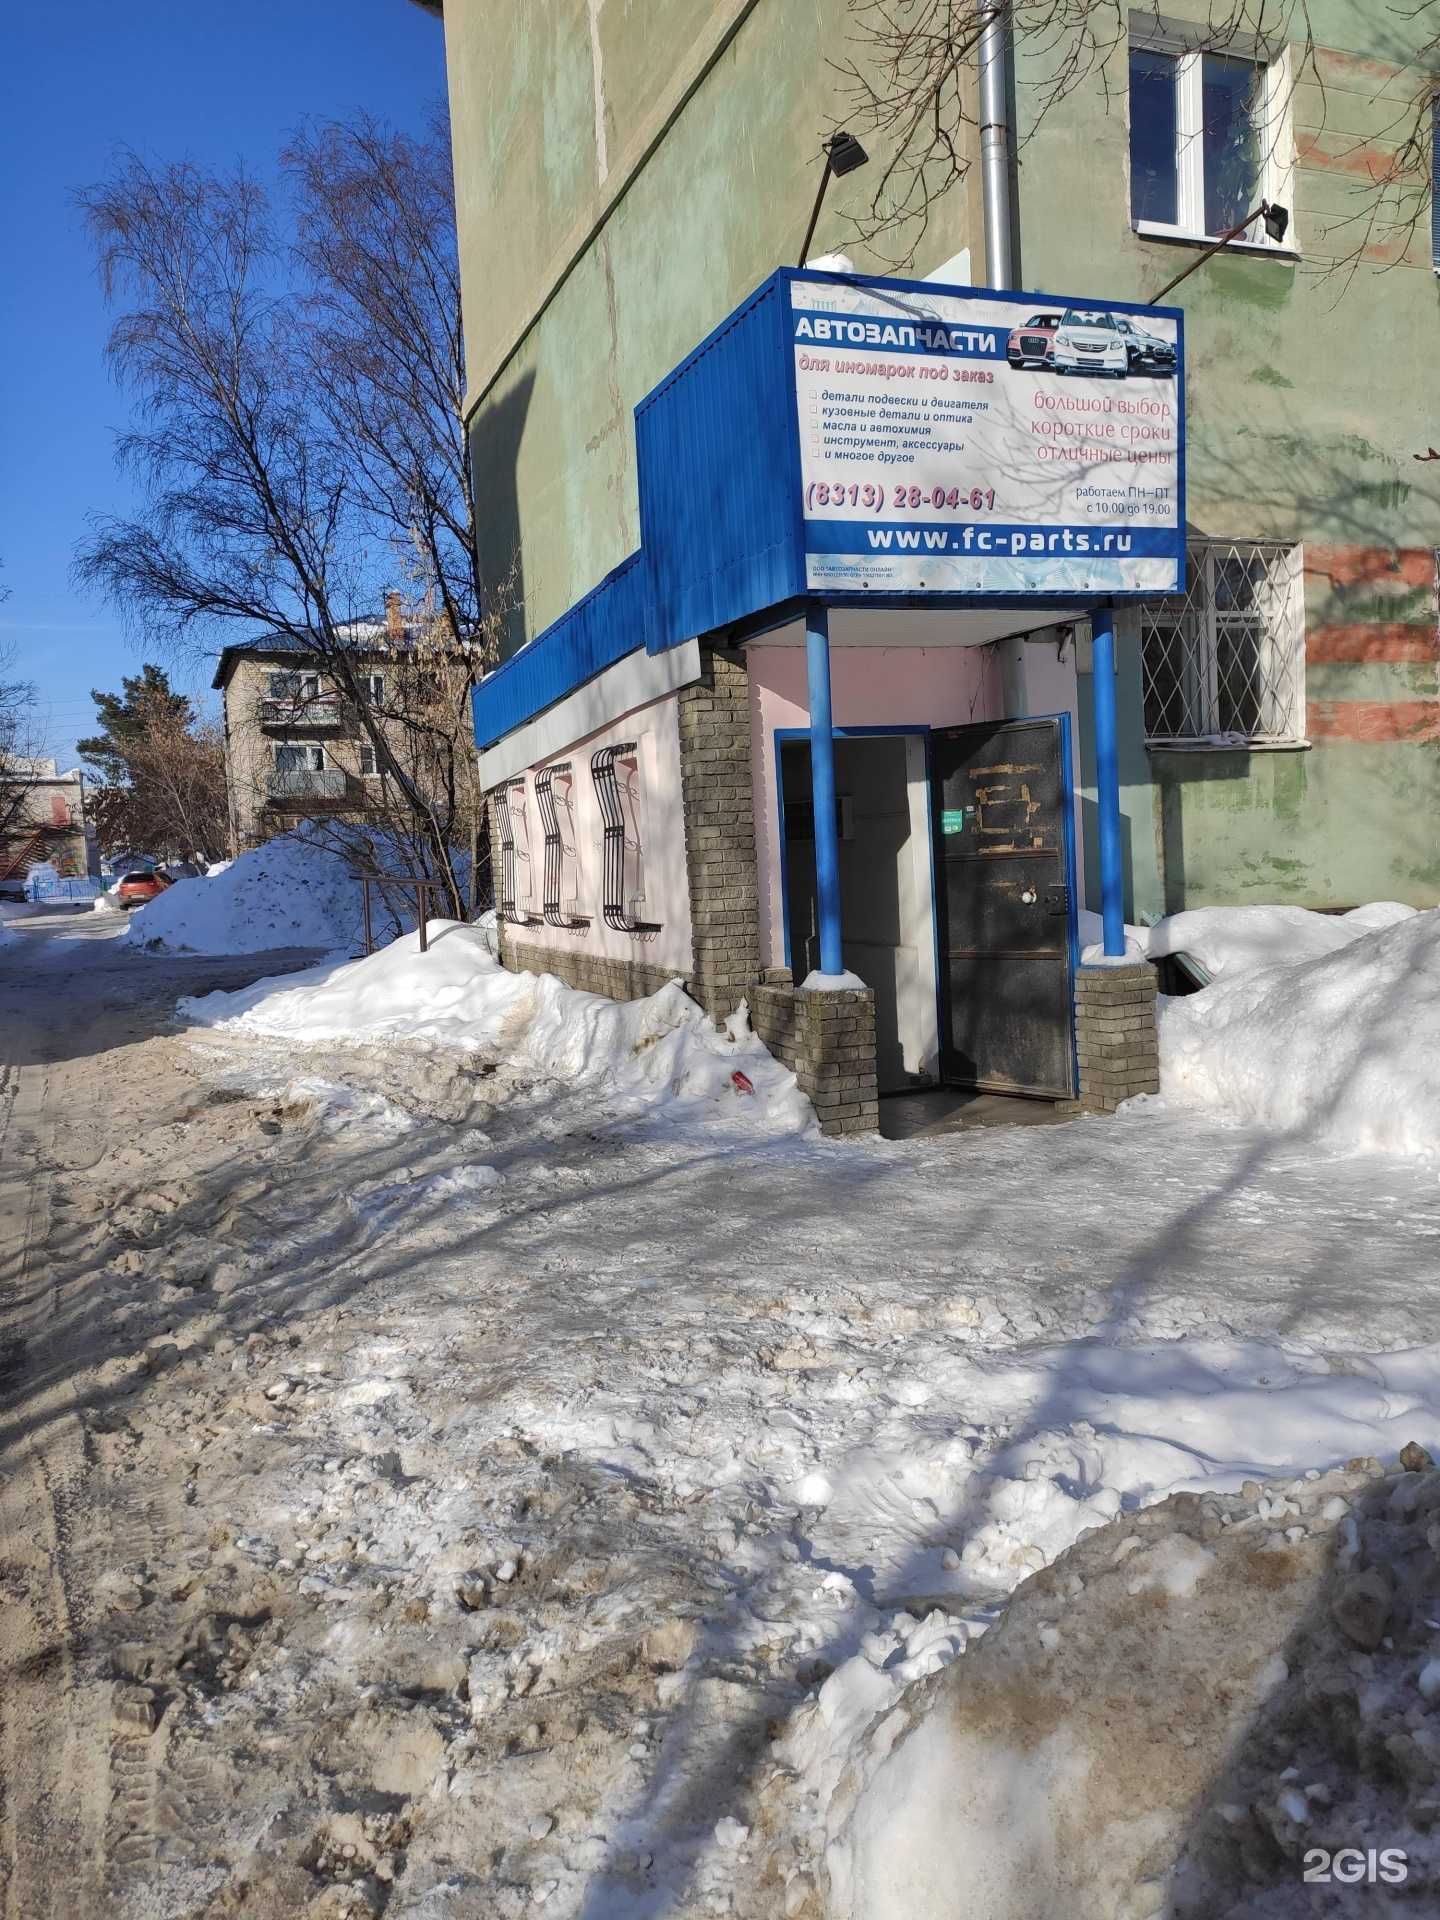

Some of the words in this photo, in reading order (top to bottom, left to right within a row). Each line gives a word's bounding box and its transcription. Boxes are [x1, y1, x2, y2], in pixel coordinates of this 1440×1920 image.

[795, 317, 996, 353] АВТОЗАПЧАСТИ
[799, 354, 830, 372] для
[834, 359, 914, 380] иномарок
[919, 365, 948, 380] под
[953, 369, 994, 384] заказ
[821, 390, 864, 403] детали
[867, 393, 918, 406] подвески
[921, 398, 928, 407] и
[930, 397, 989, 411] двигателя
[1034, 390, 1113, 413] большой
[1117, 397, 1171, 422] выбор
[822, 406, 876, 418] кузовные
[879, 408, 921, 421] детали
[923, 412, 930, 421] и
[933, 413, 973, 424] оптика
[823, 421, 857, 432] масла
[860, 423, 867, 432] и
[869, 424, 932, 435] автохимия
[1031, 421, 1115, 441] короткие
[1120, 425, 1171, 445] сроки
[823, 435, 899, 450] инструмент,
[902, 440, 965, 453] аксессуары
[824, 450, 831, 459] и
[834, 451, 875, 461] многое
[877, 450, 915, 464] другое
[1037, 446, 1122, 463] отличные
[1127, 450, 1171, 466] цены
[804, 482, 884, 512] (8313)
[892, 486, 996, 511] 28-04-61
[1076, 485, 1126, 501] работаем
[1086, 504, 1093, 513] с
[1095, 502, 1125, 514] 10.00
[1126, 503, 1140, 516] до
[1142, 503, 1171, 515] 19.00
[867, 526, 1132, 555] www.fc-parts.ru
